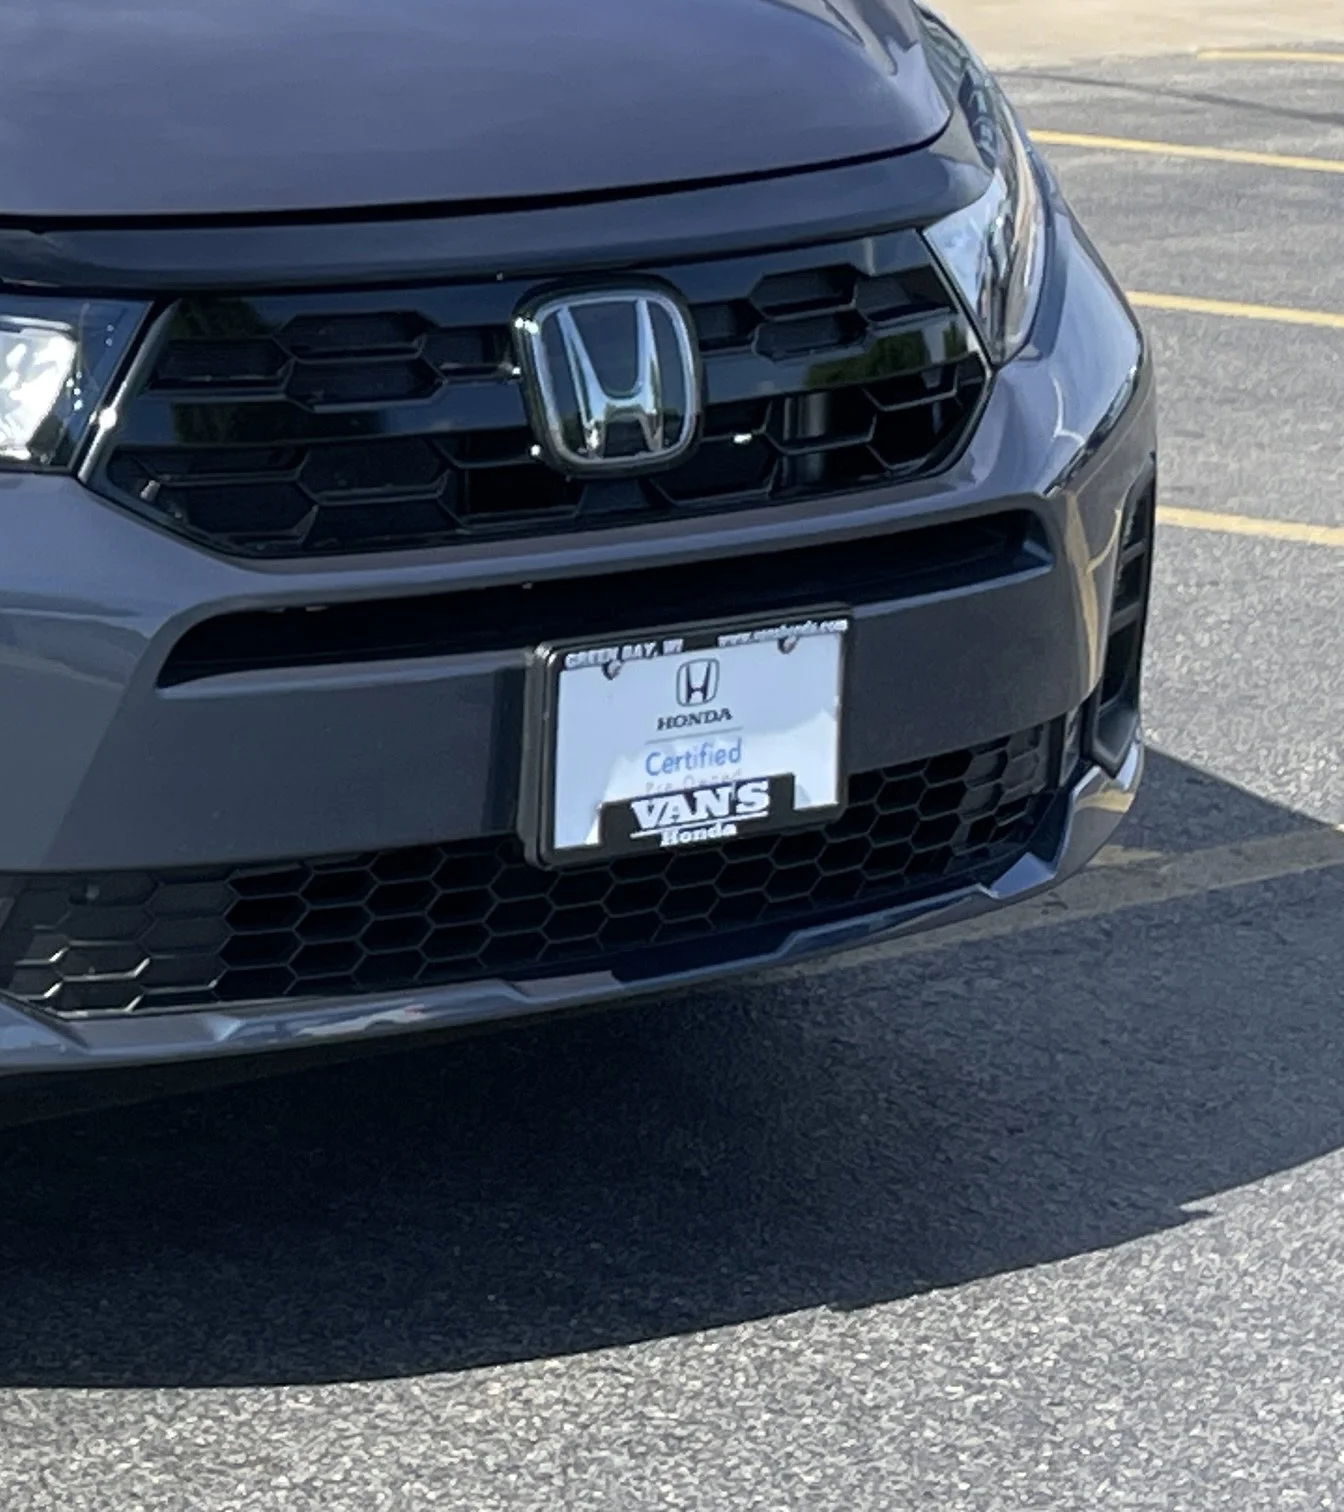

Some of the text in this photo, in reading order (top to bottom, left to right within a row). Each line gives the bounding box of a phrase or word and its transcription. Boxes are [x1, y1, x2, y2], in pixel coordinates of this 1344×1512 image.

[565, 647, 620, 669] GREEN
[621, 641, 659, 661] BAY,
[656, 707, 733, 731] HONDA
[645, 736, 742, 776] Certified
[630, 780, 770, 829] VANS
[659, 822, 738, 848] Honda
